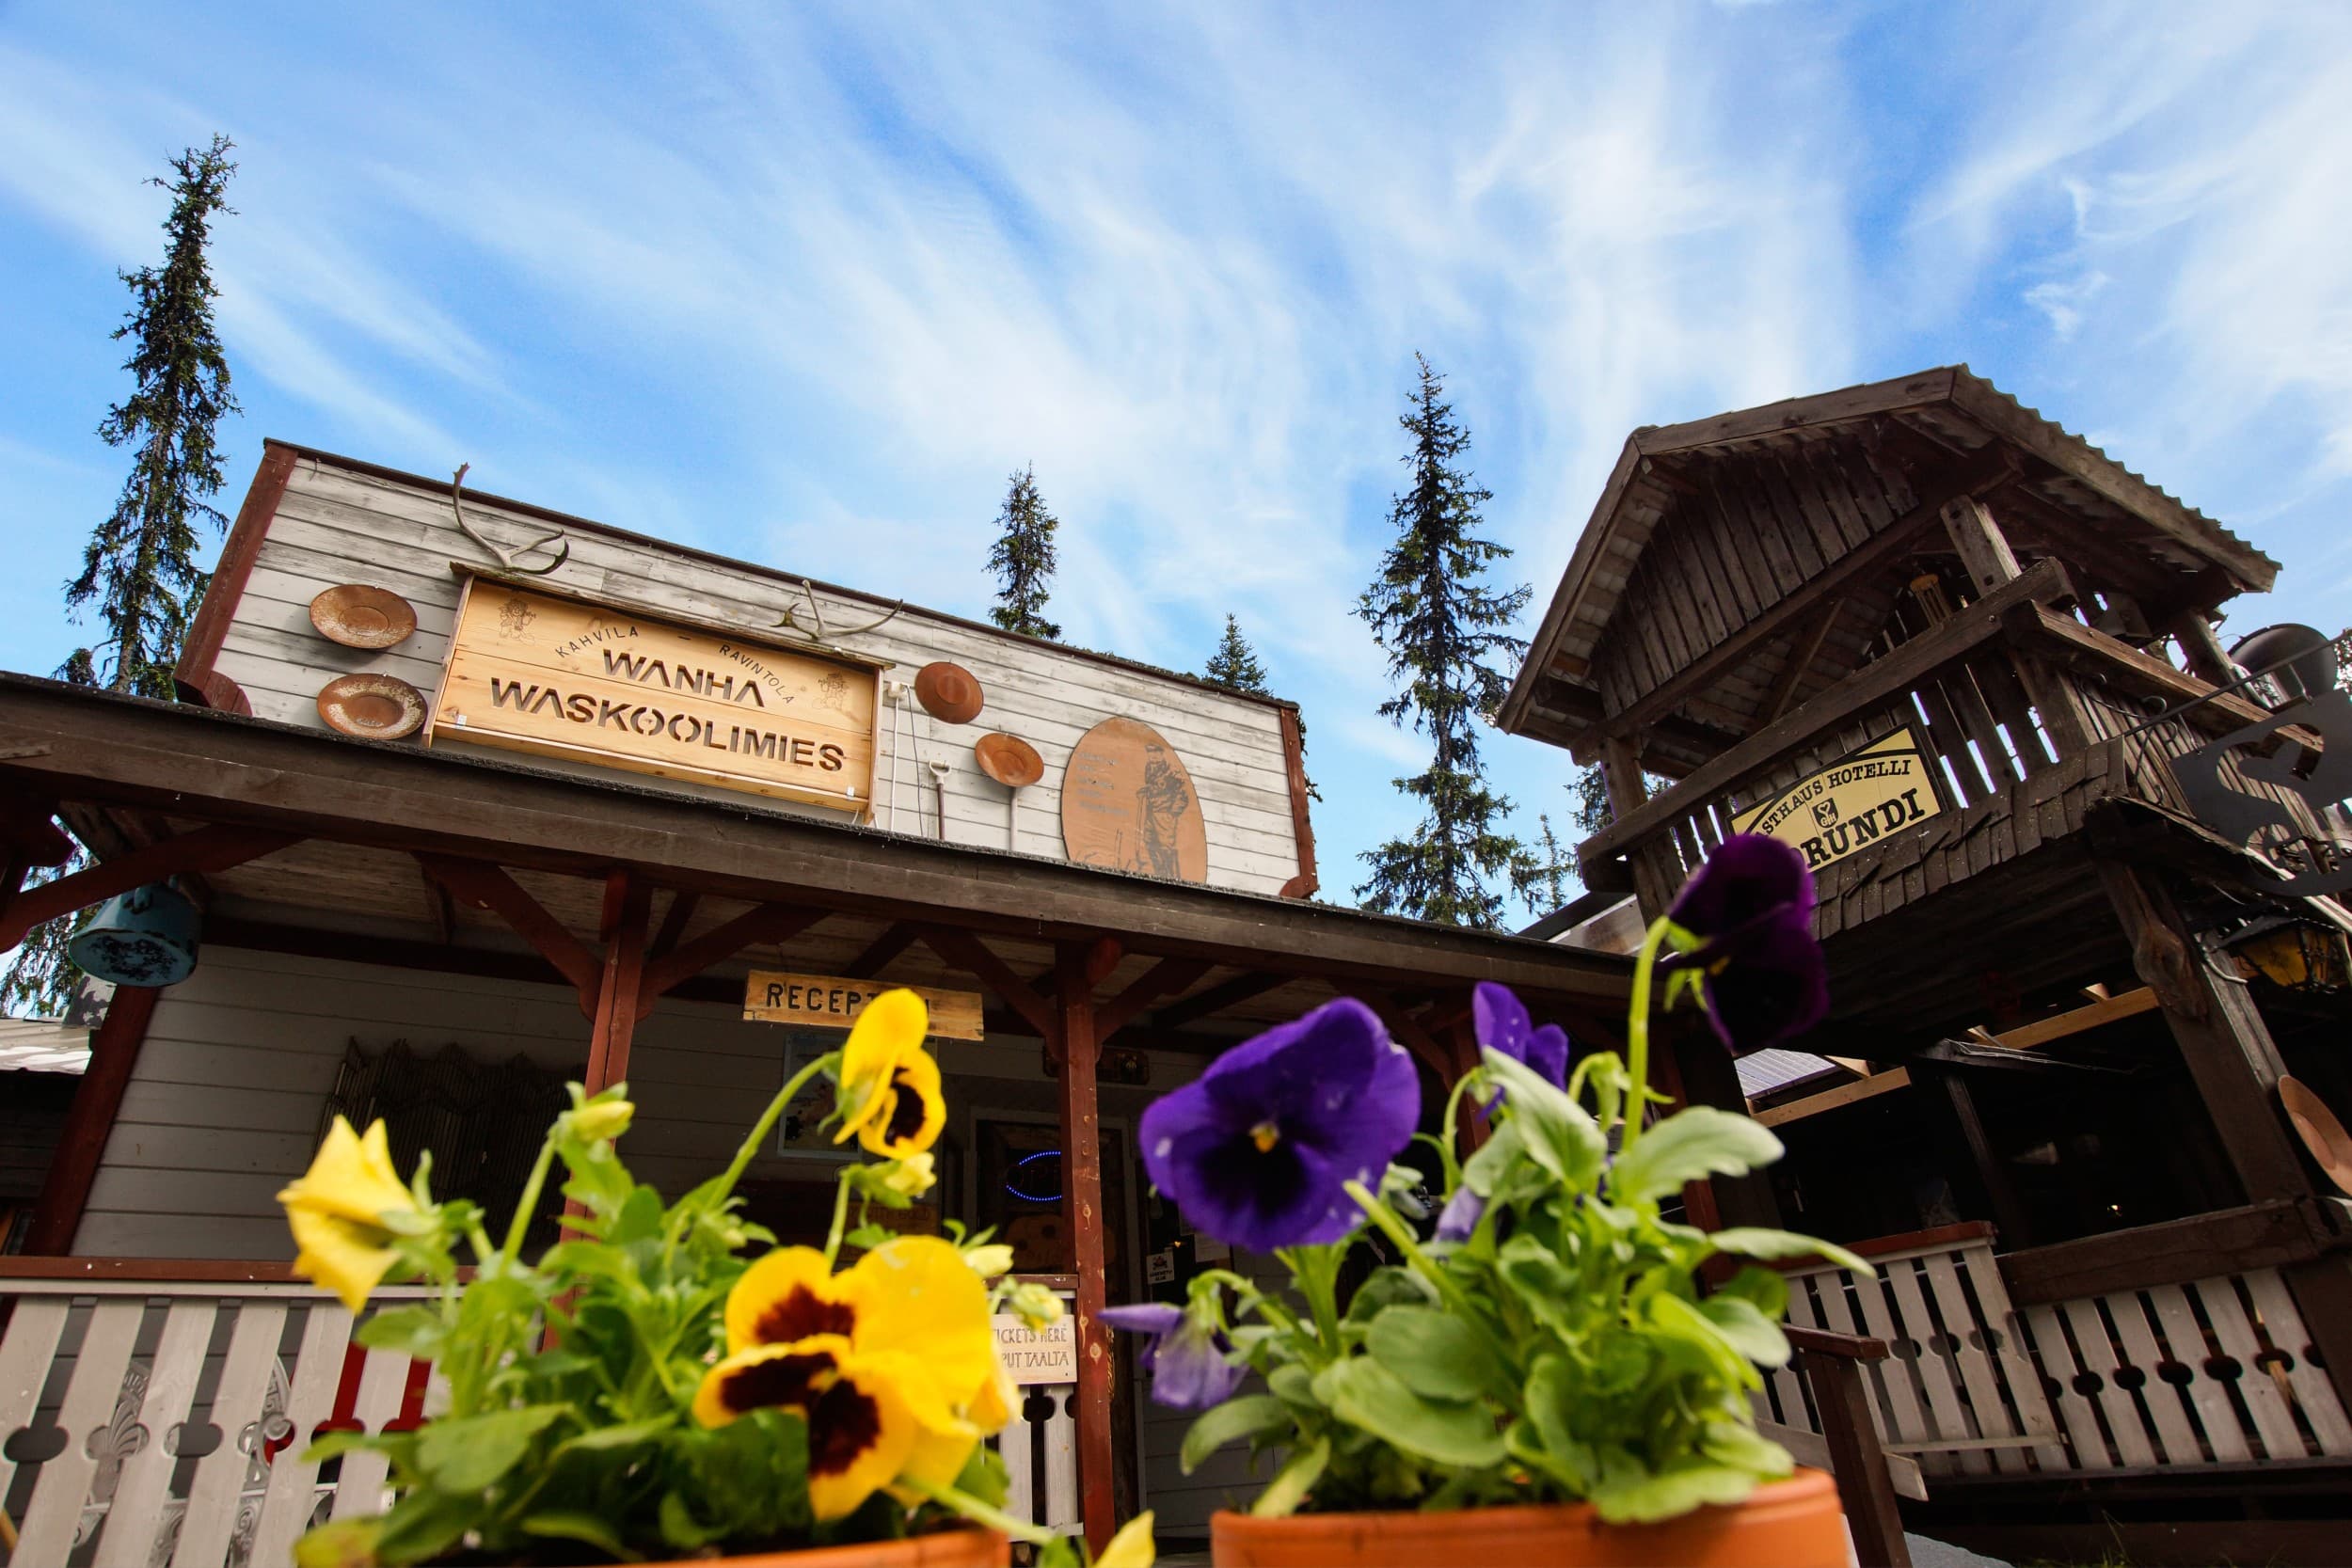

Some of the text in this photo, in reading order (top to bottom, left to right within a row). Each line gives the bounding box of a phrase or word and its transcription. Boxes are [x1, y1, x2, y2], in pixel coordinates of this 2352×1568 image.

[555, 626, 640, 658] KAHVILA
[719, 643, 796, 705] RAVINTOLA
[603, 648, 765, 708] WANHA
[490, 676, 847, 772] WASKOOLIMIES
[1756, 759, 1911, 836] STHAUS HOTELLI
[1790, 787, 1926, 869] RUNDI
[766, 982, 930, 1017] RECEP
